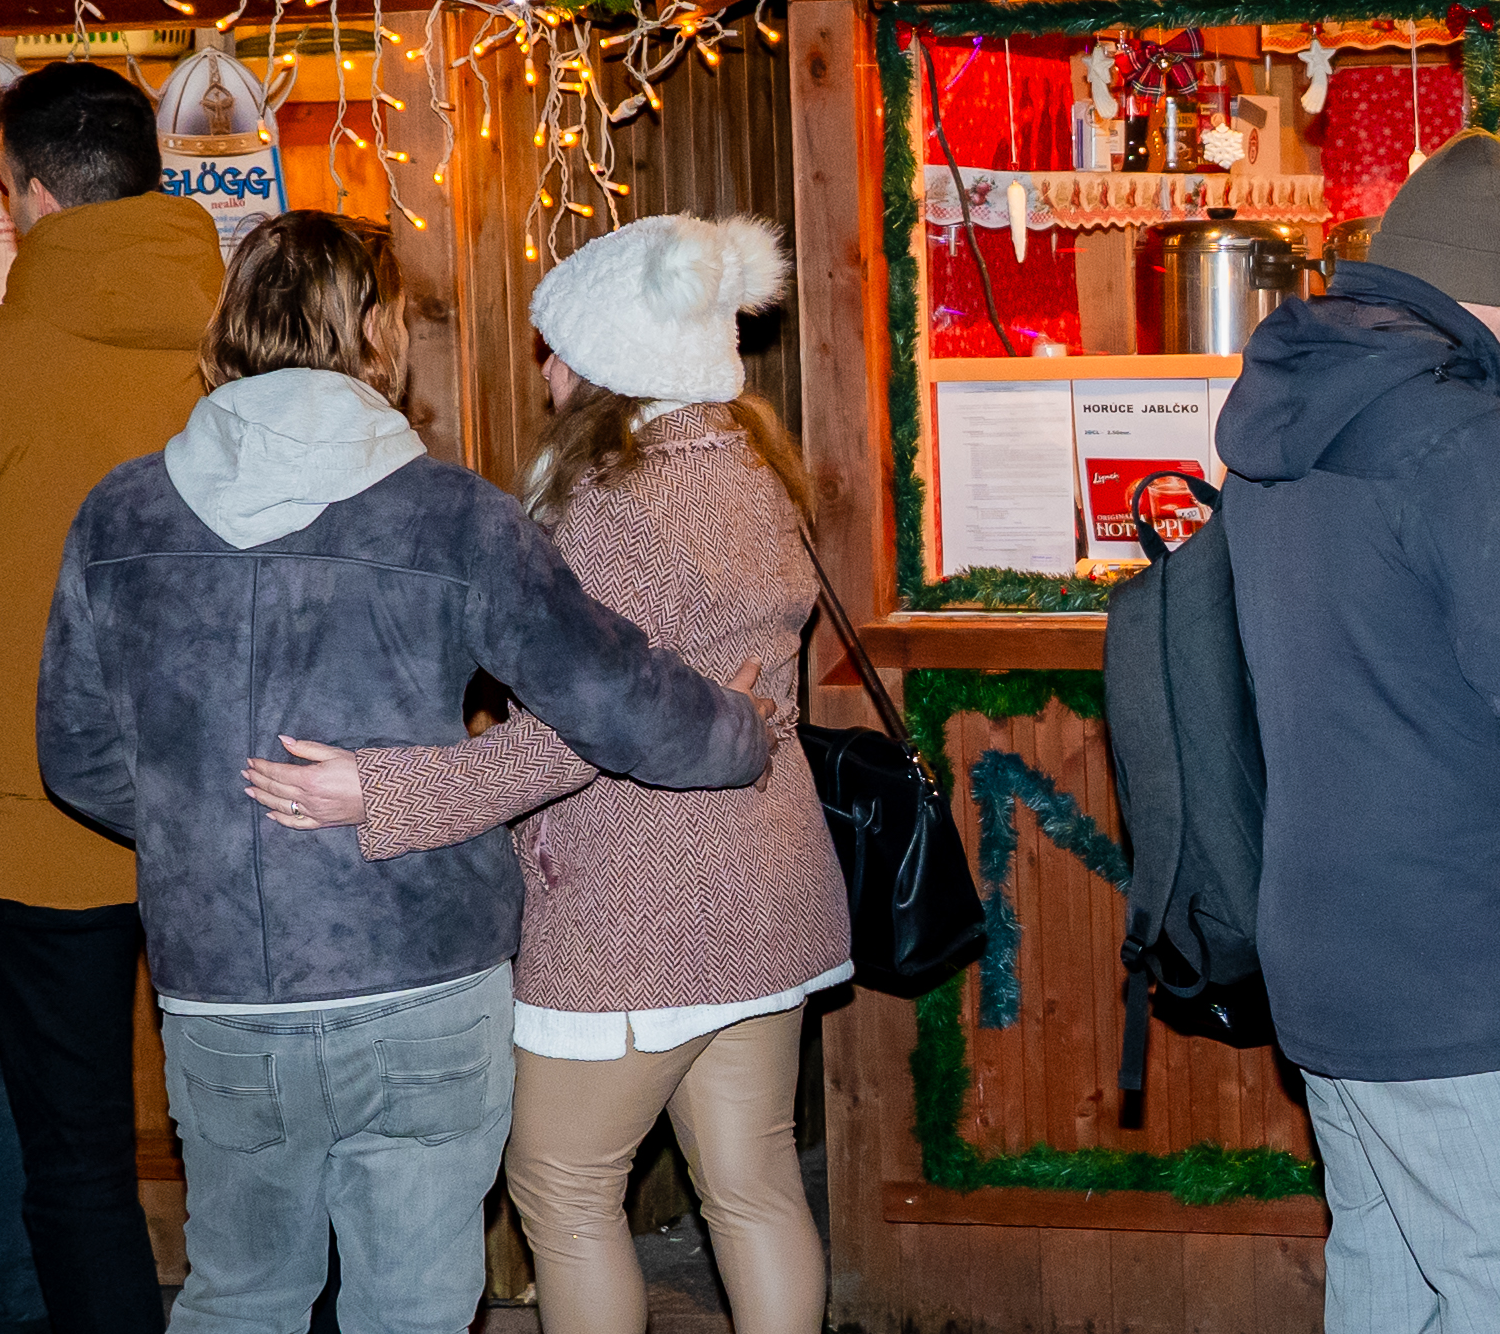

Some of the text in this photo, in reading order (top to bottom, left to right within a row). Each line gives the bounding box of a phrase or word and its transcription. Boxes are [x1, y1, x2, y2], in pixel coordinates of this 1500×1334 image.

[161, 161, 276, 200] GLÖGG
[1083, 402, 1199, 414] HORÚCE JABLČKO
[1096, 515, 1197, 539] HOT PPL
